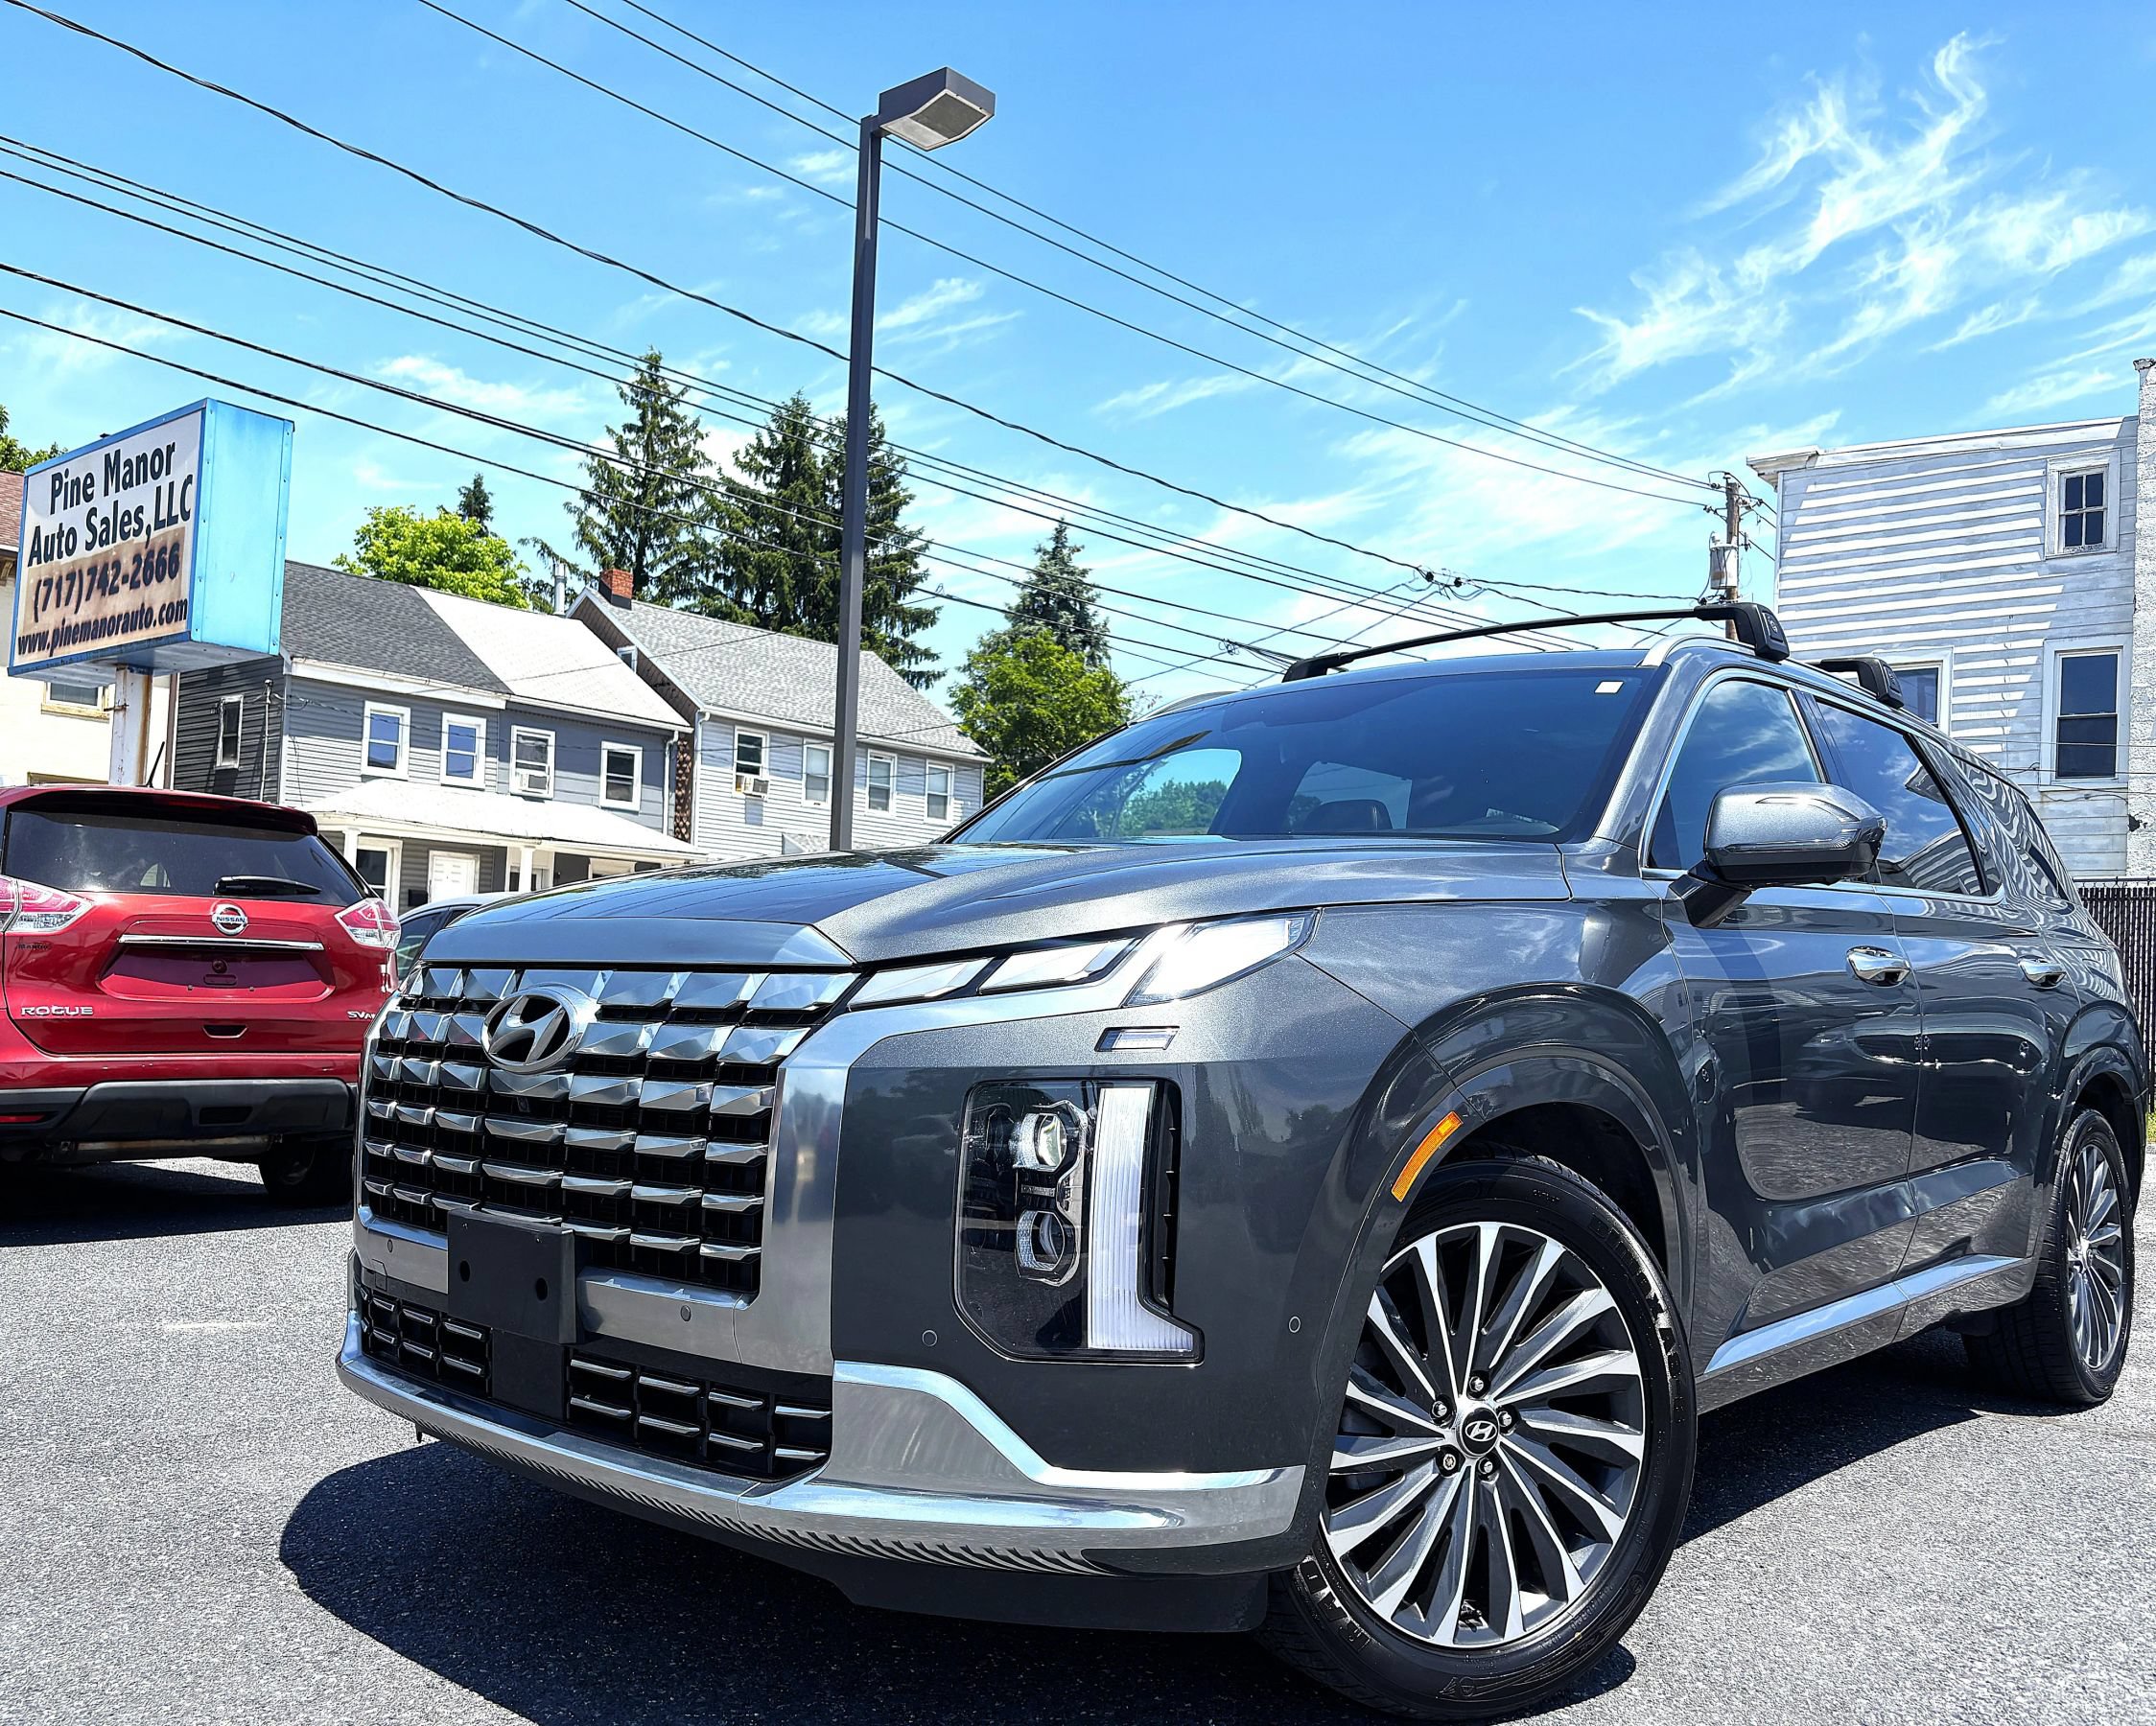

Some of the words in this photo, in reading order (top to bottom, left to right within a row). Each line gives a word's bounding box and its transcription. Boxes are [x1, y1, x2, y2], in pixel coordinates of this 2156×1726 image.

[50, 468, 94, 515] Pine
[104, 442, 176, 497] Manor
[28, 523, 77, 567] Auto
[17, 597, 187, 657] www.pinemanorauto.com
[21, 1005, 93, 1016] ROGUE
